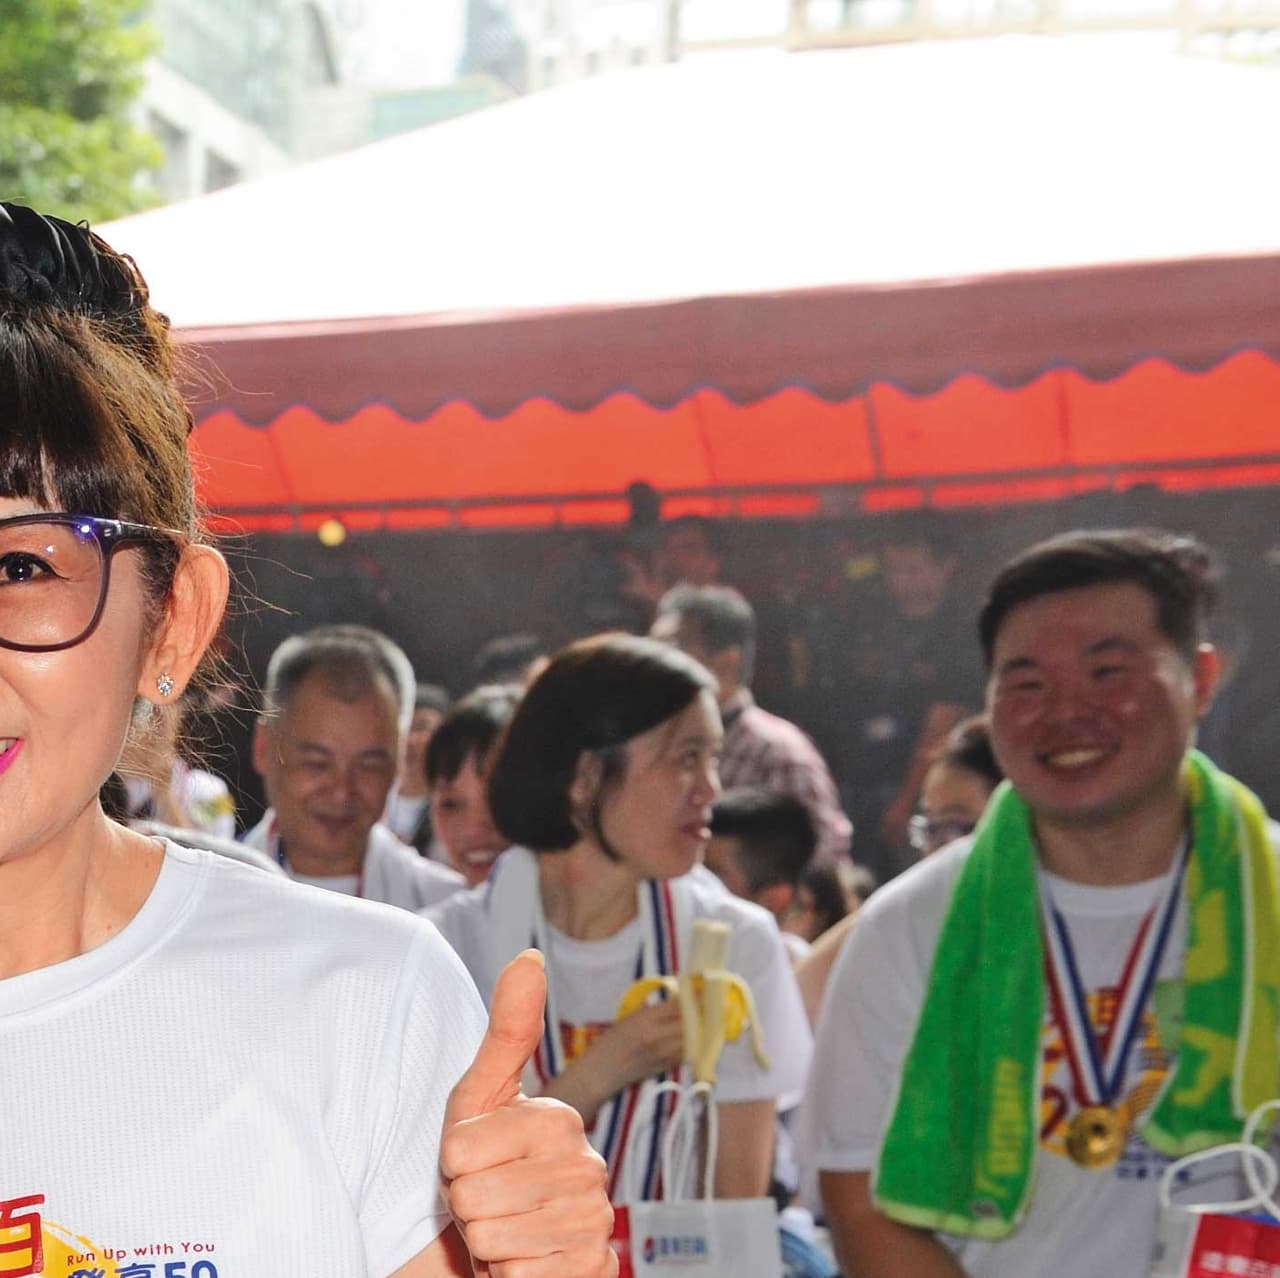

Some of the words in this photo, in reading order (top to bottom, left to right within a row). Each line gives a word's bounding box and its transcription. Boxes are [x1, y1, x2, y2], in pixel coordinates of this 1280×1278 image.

[67, 1252, 96, 1266] Run
[103, 1249, 127, 1262] Up
[134, 1243, 174, 1257] with
[181, 1242, 216, 1253] You
